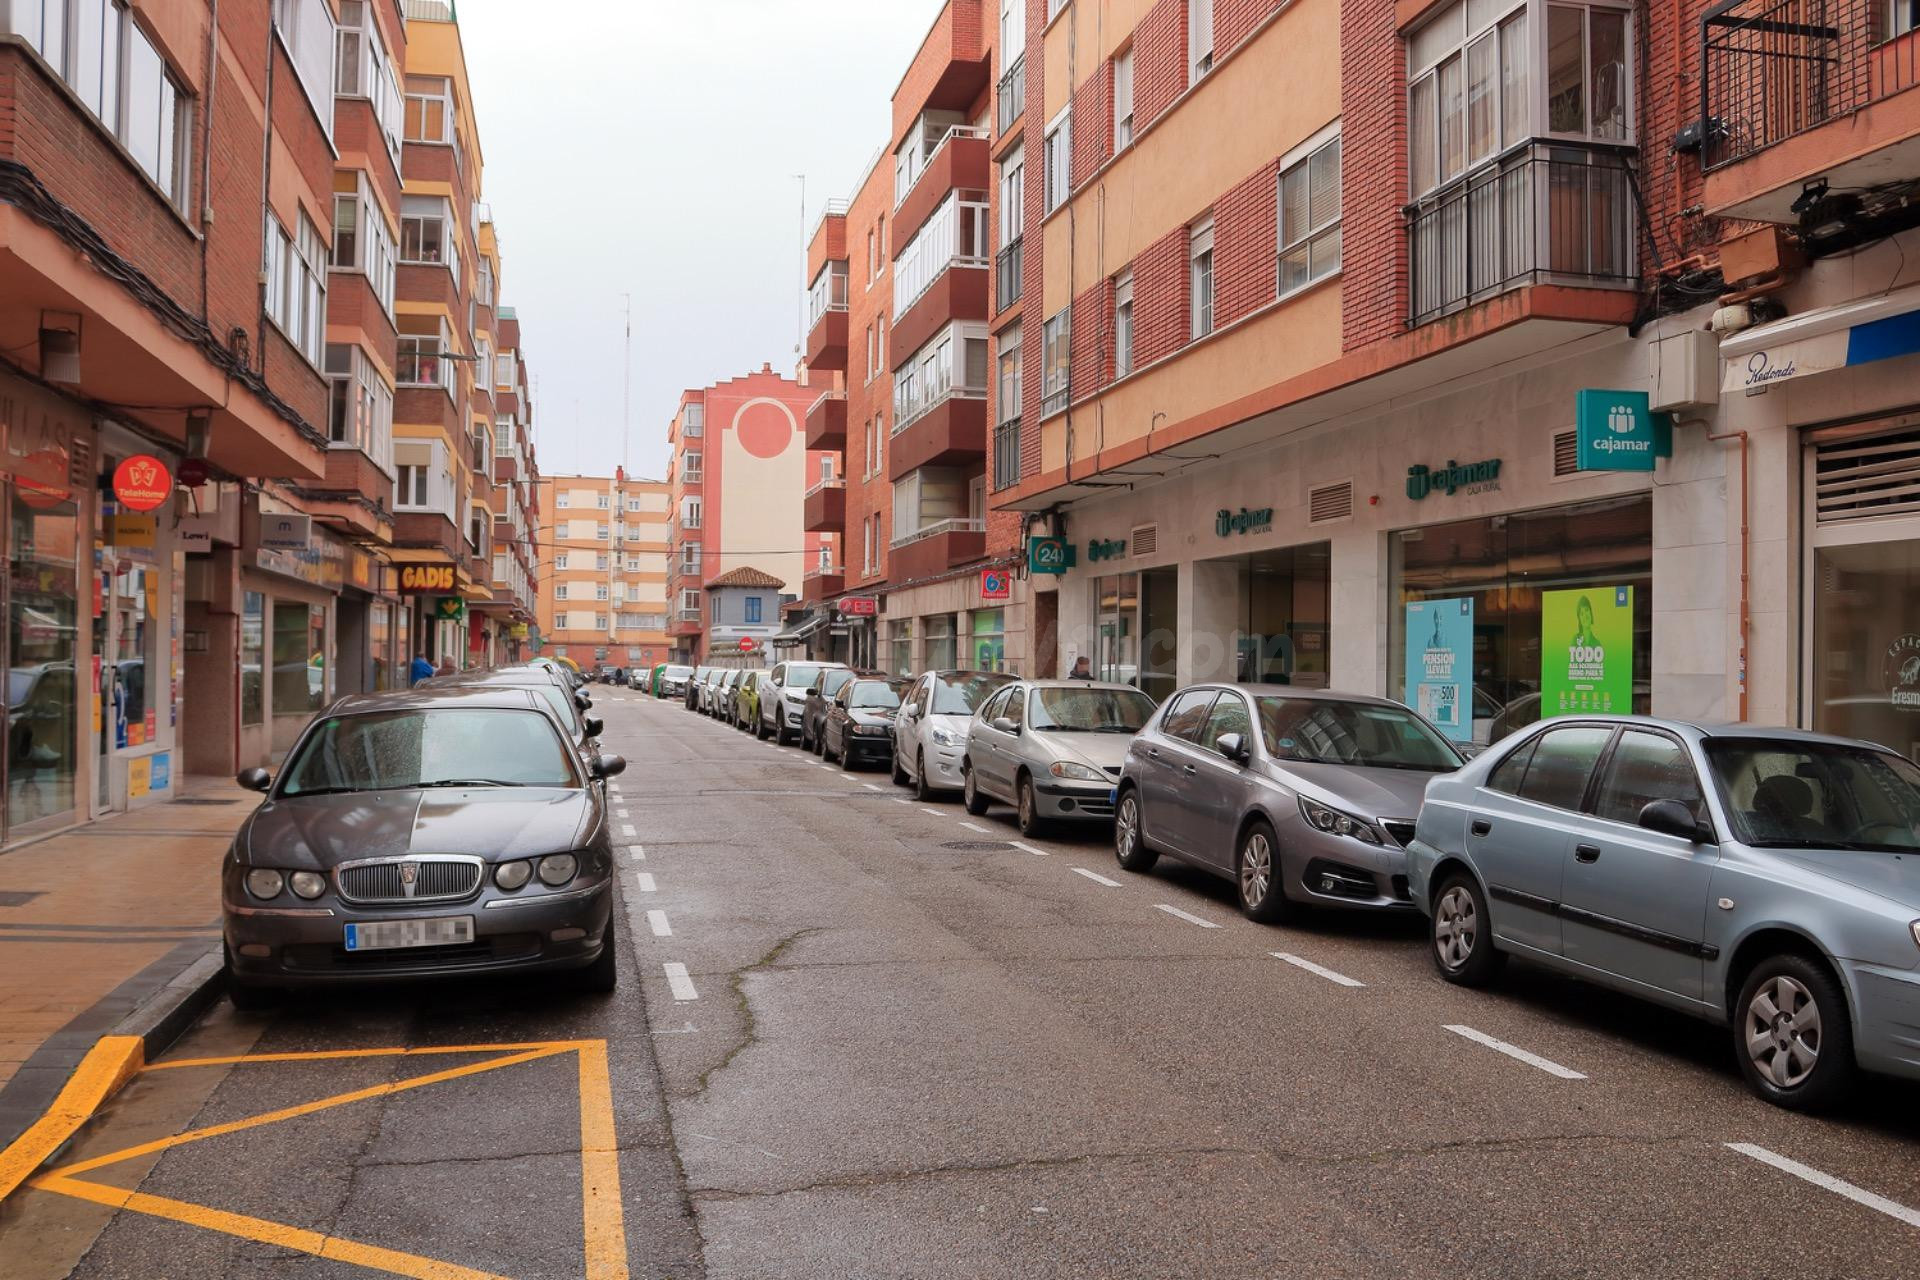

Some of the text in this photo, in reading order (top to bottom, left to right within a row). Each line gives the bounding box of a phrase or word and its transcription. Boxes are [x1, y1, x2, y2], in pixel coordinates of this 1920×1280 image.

[1745, 352, 1796, 385] Redondo
[1592, 436, 1650, 455] cajamar
[1431, 459, 1502, 496] cajamar
[118, 488, 166, 499] TeleHome
[402, 566, 454, 590] GADIS
[1568, 646, 1605, 662] TODO
